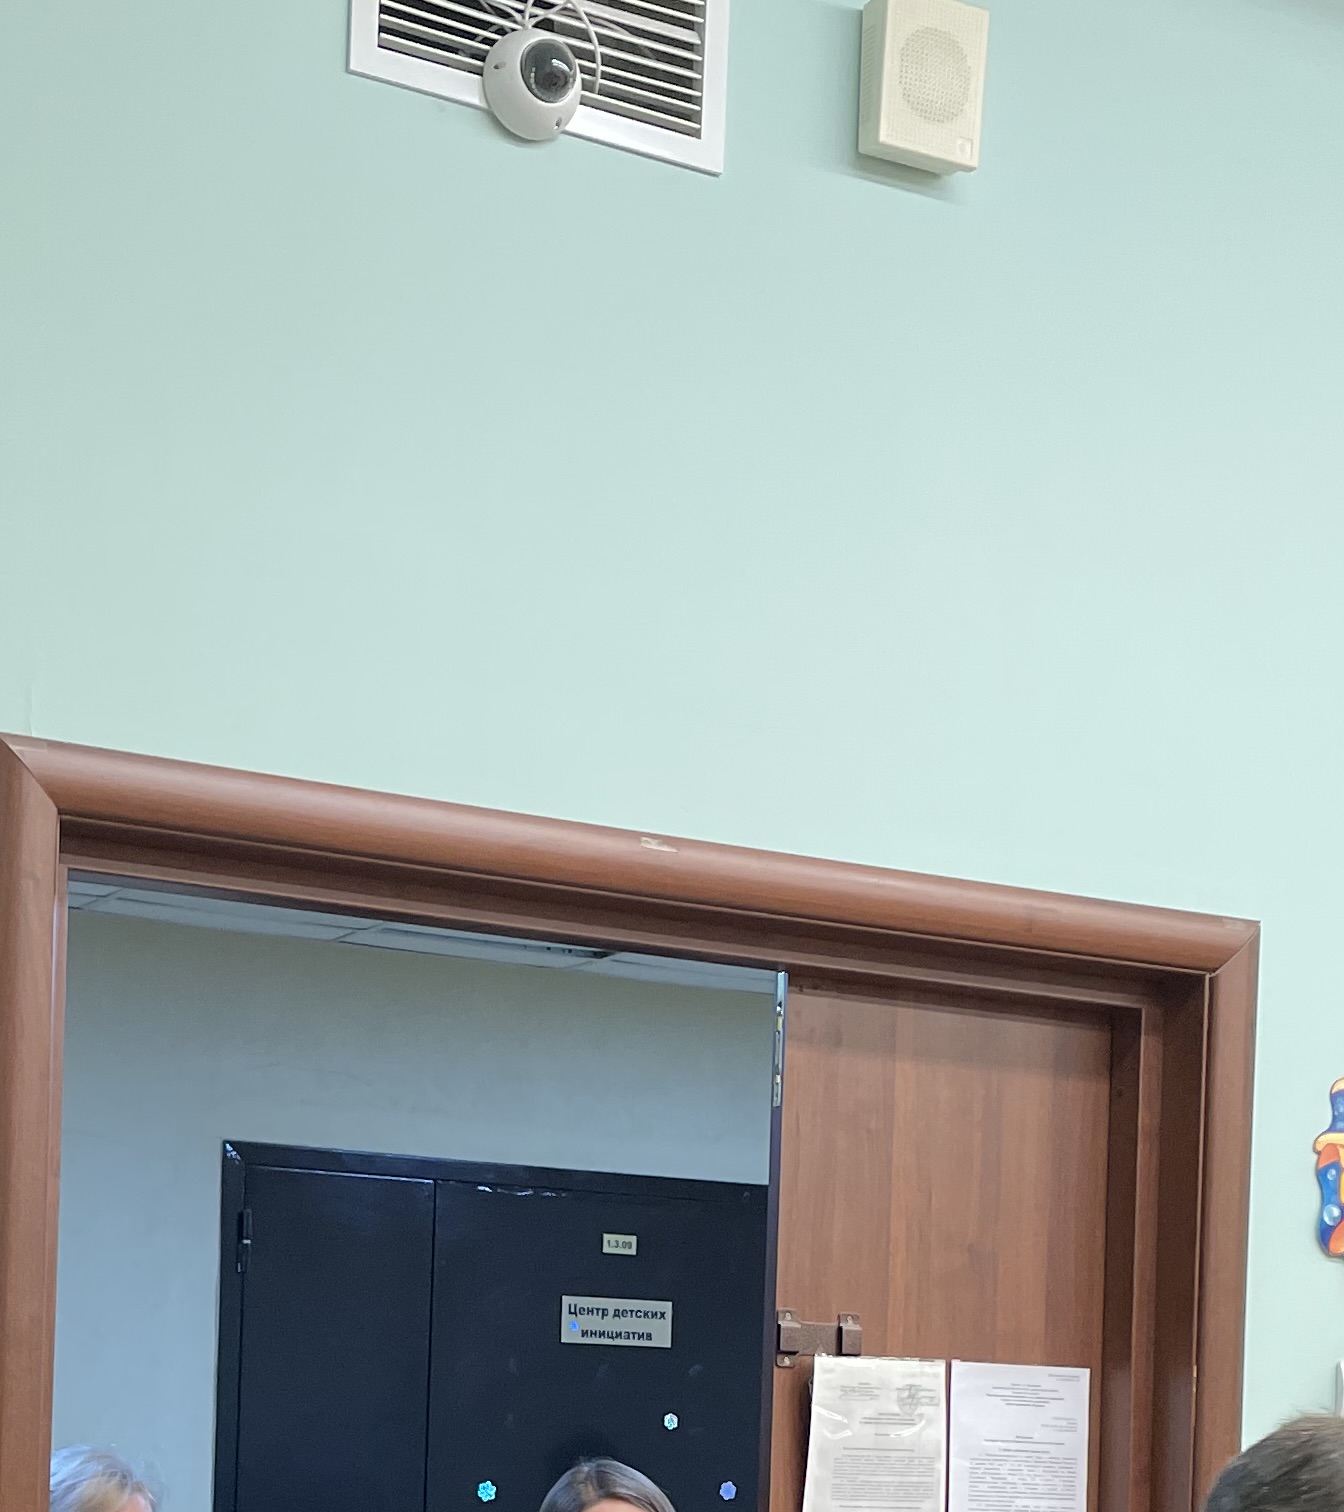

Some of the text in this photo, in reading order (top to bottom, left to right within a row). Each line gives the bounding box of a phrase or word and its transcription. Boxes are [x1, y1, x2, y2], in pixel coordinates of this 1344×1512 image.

[607, 1239, 633, 1250] 1.3.09
[568, 1303, 667, 1320] Центр детских
[581, 1329, 653, 1341] инициатив
